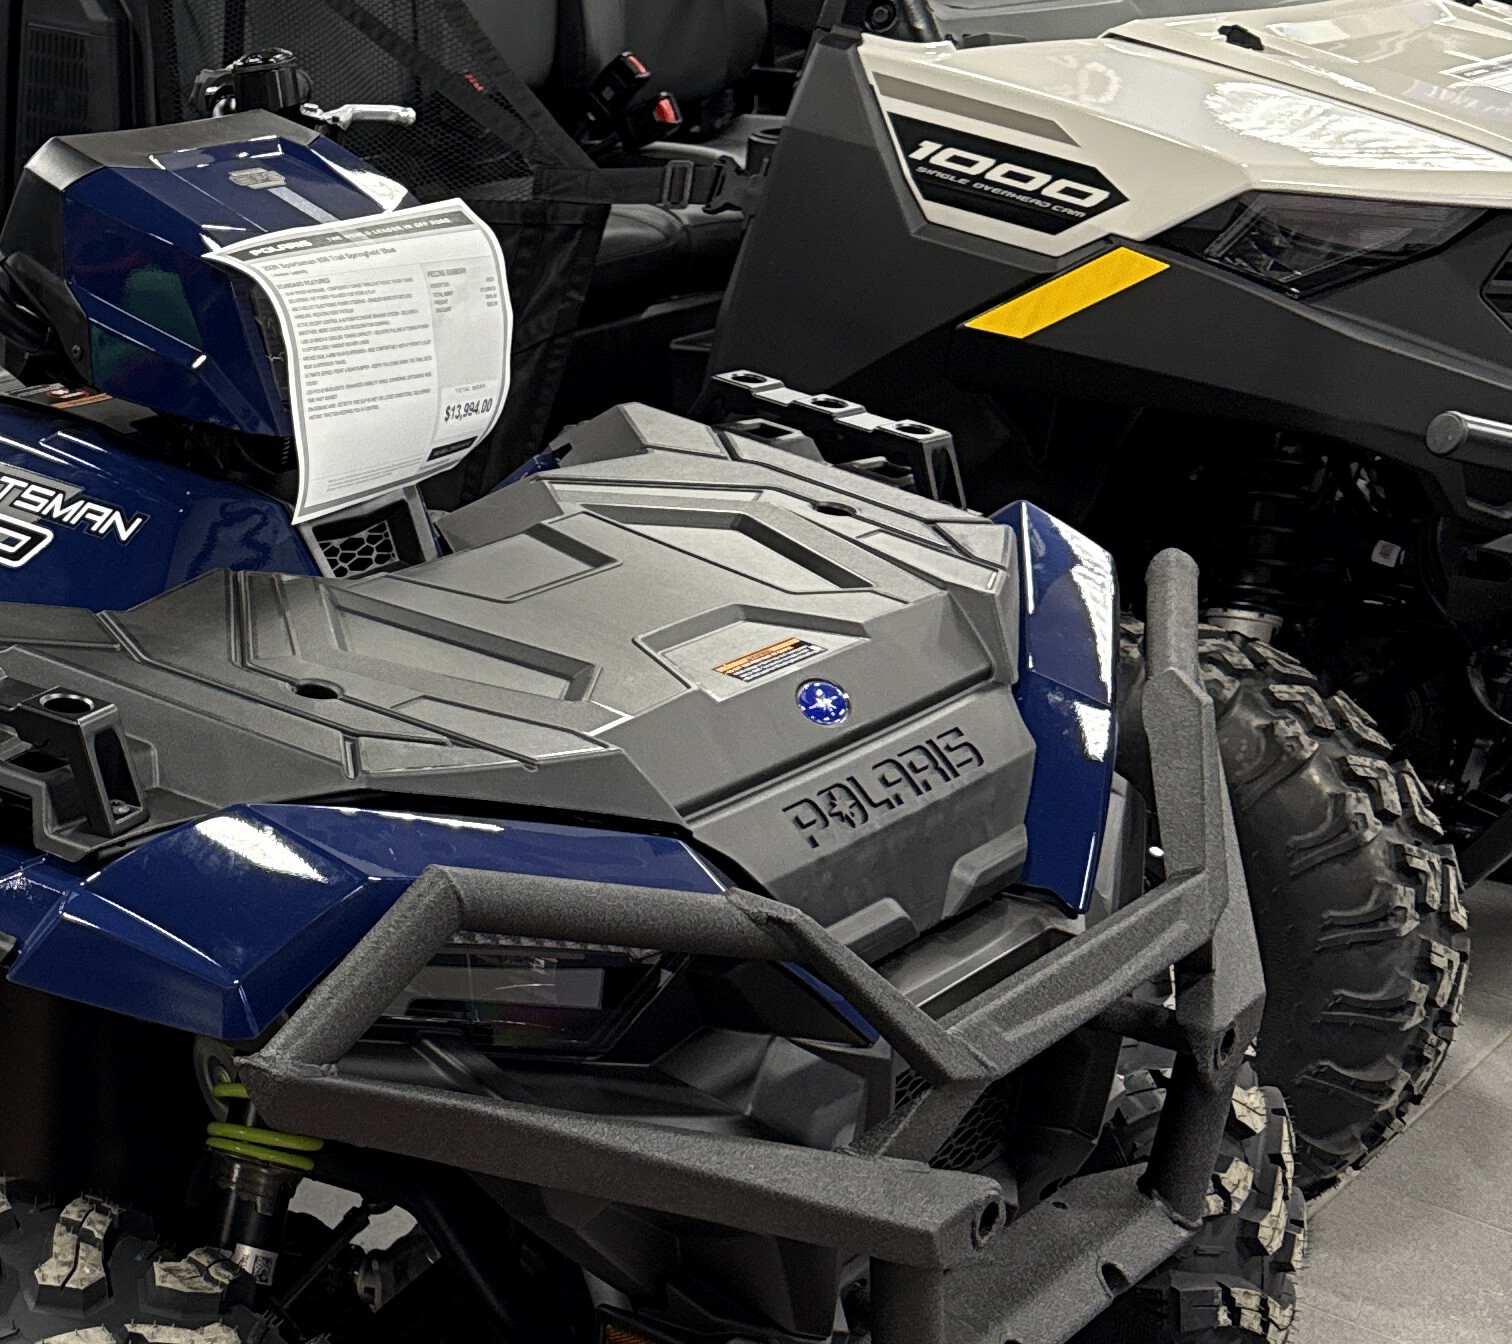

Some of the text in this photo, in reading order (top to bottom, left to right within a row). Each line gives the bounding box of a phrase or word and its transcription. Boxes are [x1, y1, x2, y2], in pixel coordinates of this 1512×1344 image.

[908, 140, 1111, 208] 1000
[915, 166, 1087, 218] SINGLE OVERHEAD CAM
[249, 239, 313, 256] POLARIS
[444, 398, 493, 423] $13,994.00
[781, 726, 986, 848] POLARIS
